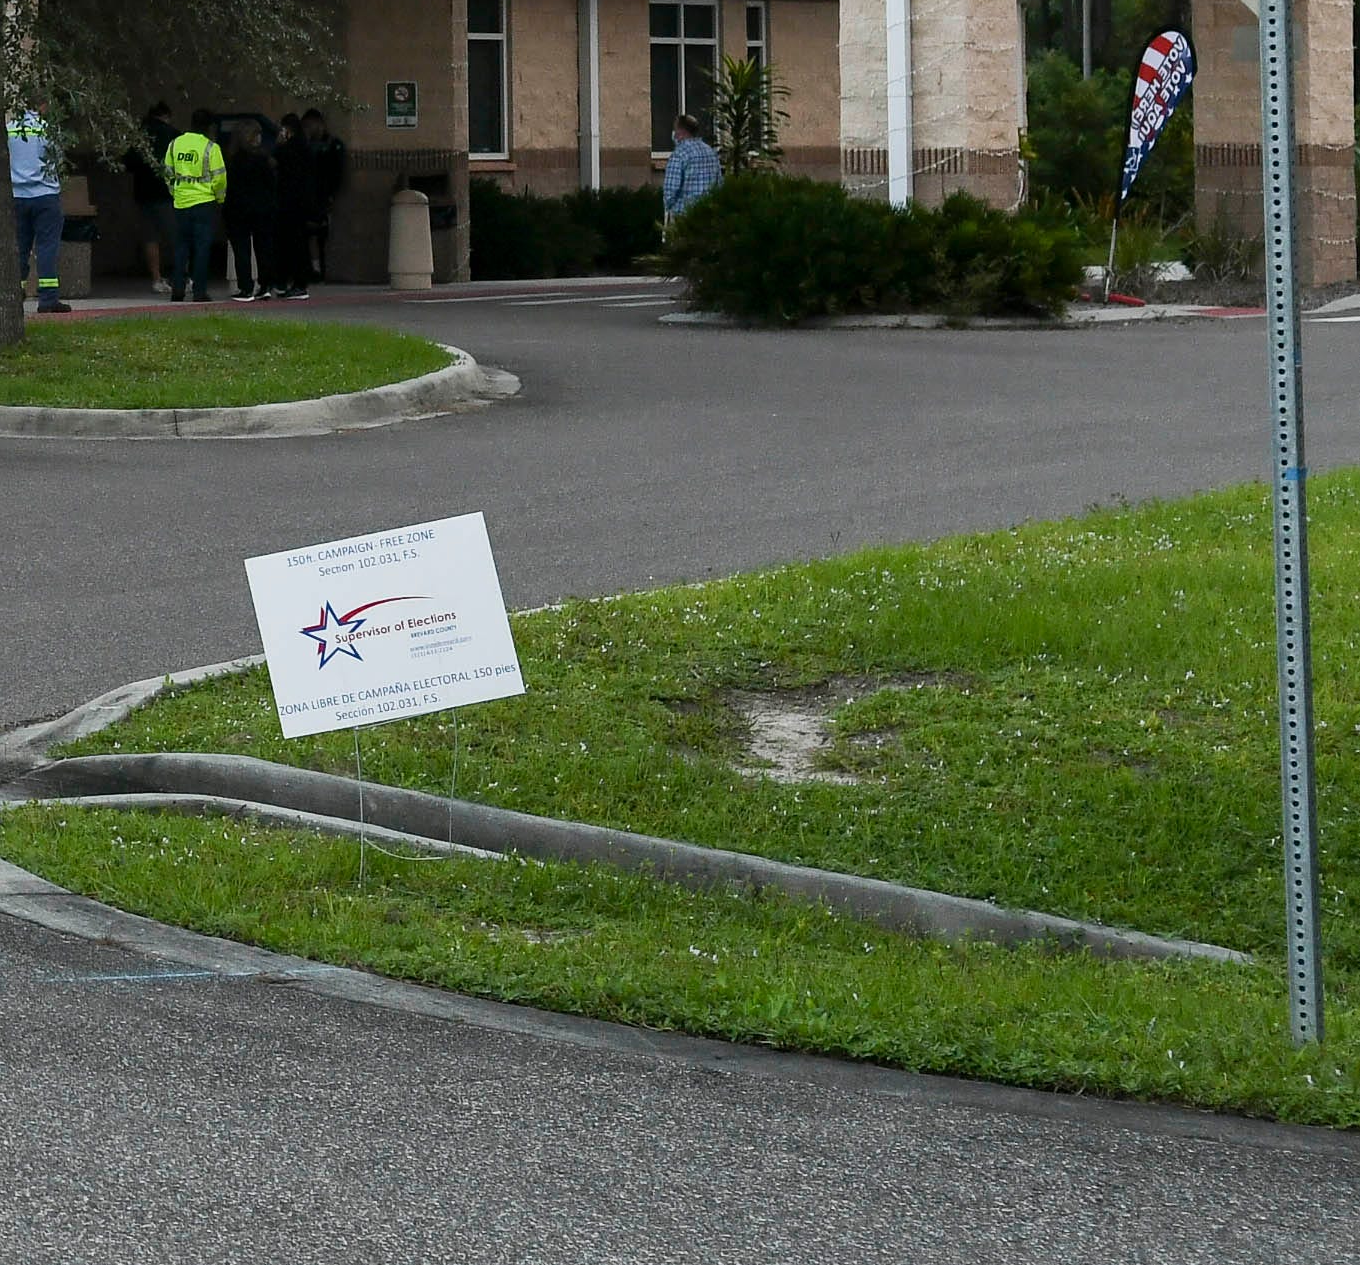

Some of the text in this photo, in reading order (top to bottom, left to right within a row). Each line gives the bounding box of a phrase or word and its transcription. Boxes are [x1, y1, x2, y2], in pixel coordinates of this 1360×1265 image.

[407, 529, 436, 544] ZONE
[318, 562, 355, 577] Section
[335, 624, 391, 644] Supervisor
[394, 620, 405, 632] of
[407, 612, 457, 629] Elections
[279, 663, 517, 716] ZONA LIBRE DE CAMPAÑA ELECTORAL 150 pies
[423, 692, 441, 705] F.S.
